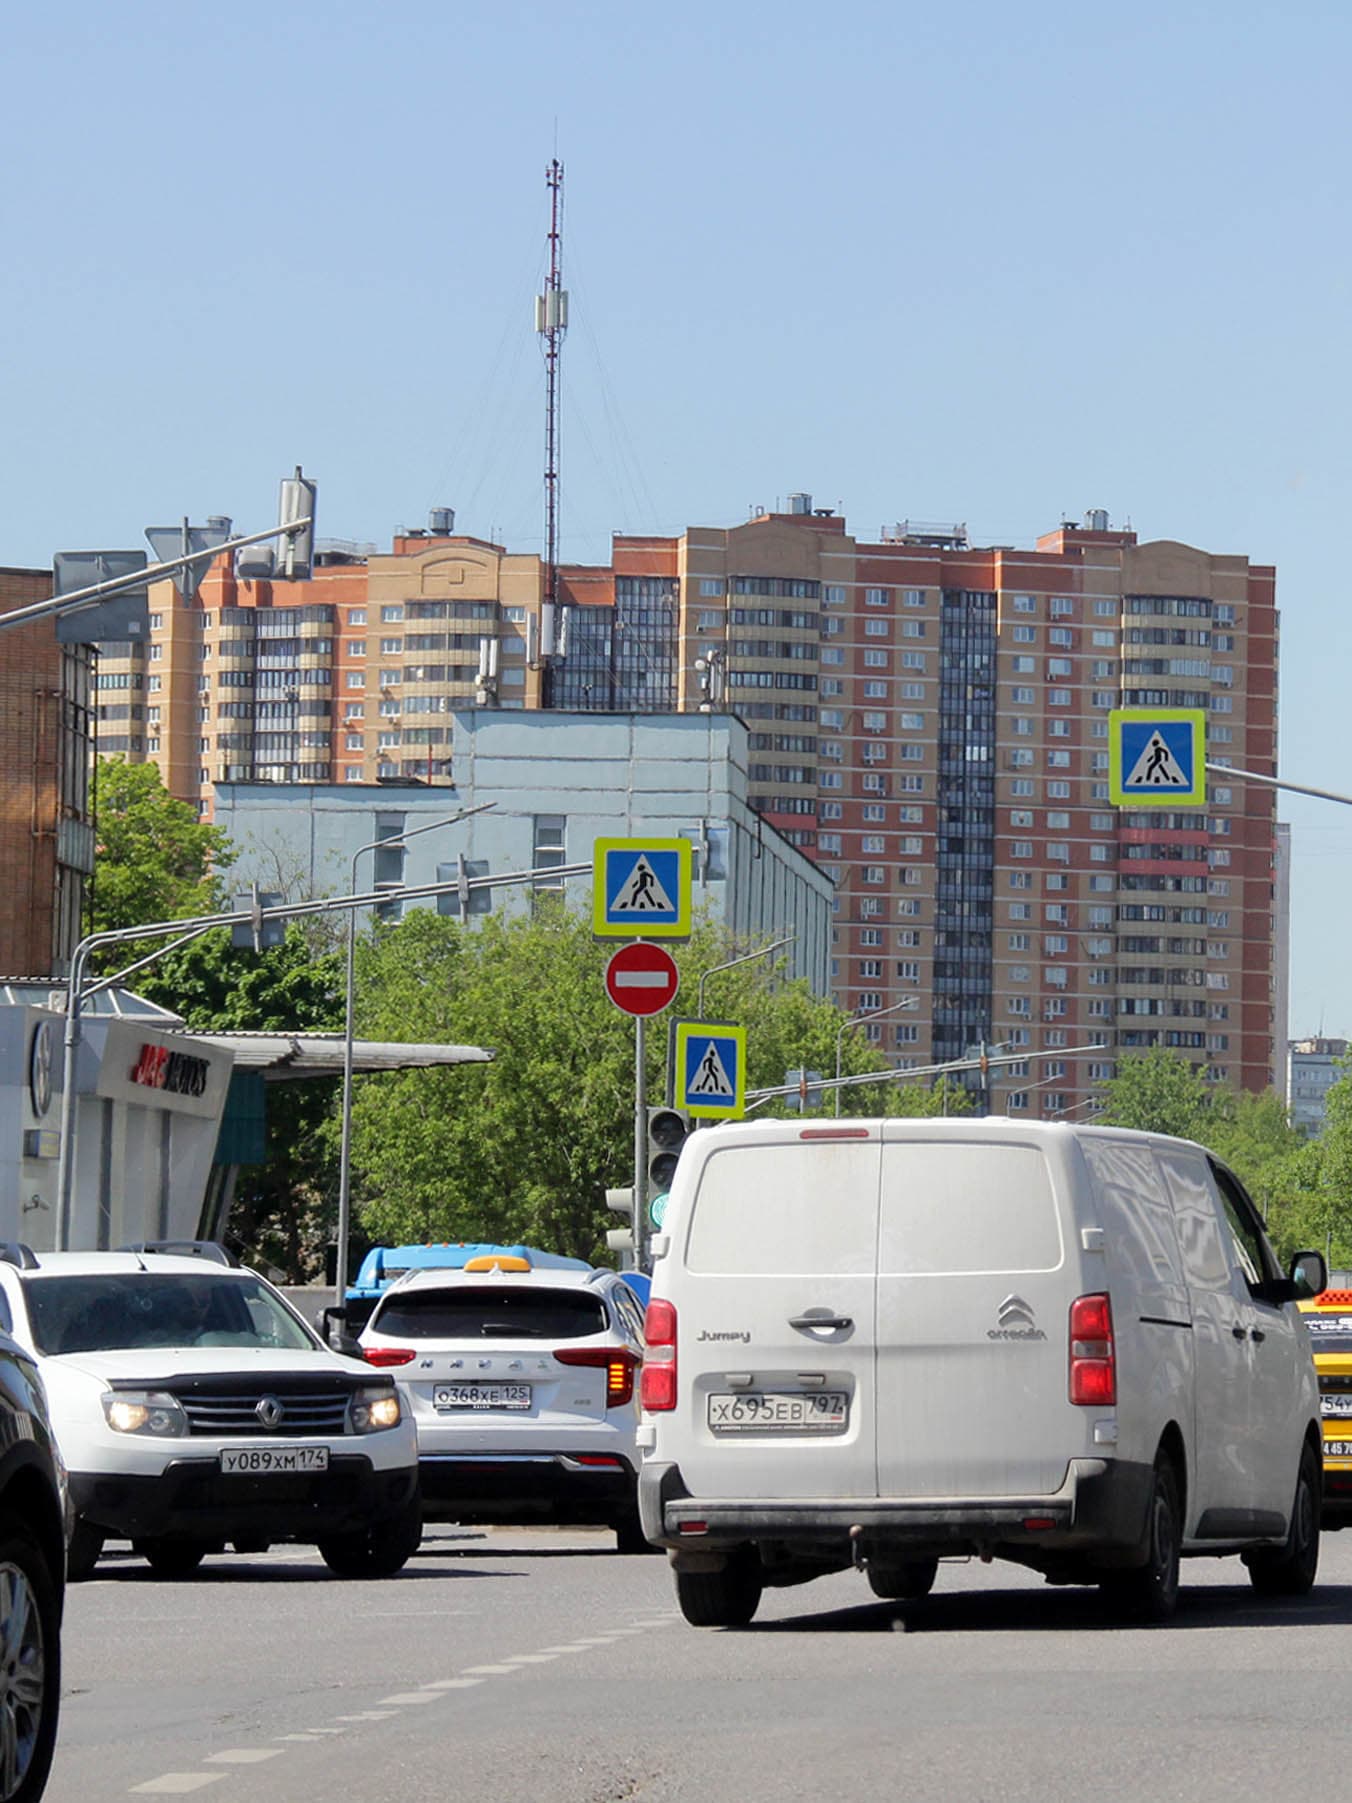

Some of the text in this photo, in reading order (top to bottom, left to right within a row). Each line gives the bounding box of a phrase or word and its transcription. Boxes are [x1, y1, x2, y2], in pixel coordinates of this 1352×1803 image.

[130, 1044, 169, 1089] JAC
[697, 1330, 751, 1344] Jumpy
[503, 1386, 526, 1399] 125
[717, 1396, 841, 1421] Х695ЕВ 797
[227, 1449, 324, 1470] У089ХМ 174
